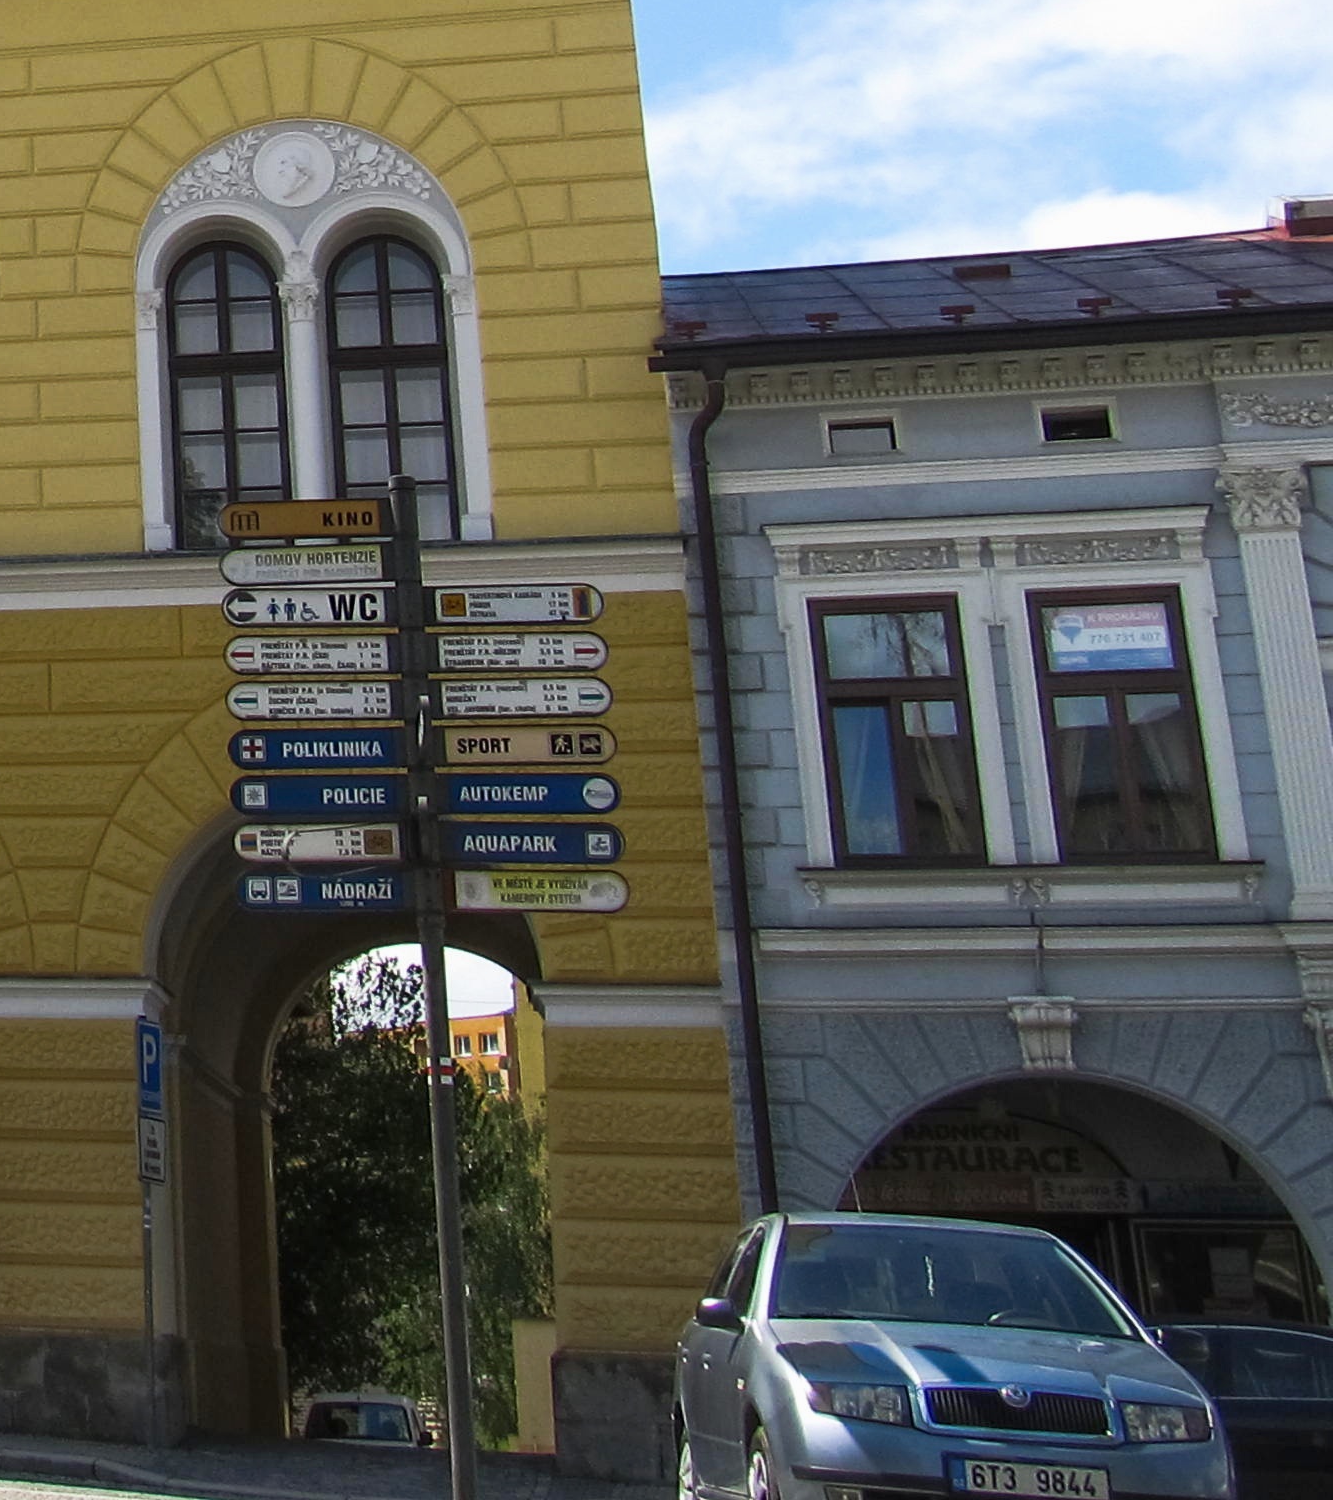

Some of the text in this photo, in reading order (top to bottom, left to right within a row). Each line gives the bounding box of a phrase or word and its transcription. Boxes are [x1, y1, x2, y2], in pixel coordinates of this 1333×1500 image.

[323, 512, 373, 526] KINO
[256, 550, 376, 566] DOMOV HORTENZIE
[328, 593, 378, 621] WC
[283, 741, 383, 758] POLIKLINIKA
[457, 738, 510, 754] SPORT
[323, 788, 386, 804] POLICIE
[460, 786, 548, 801] AUTOKEMP
[464, 835, 557, 853] AQUAPARK
[322, 878, 393, 900] NÁDRAŽÍ
[142, 1033, 156, 1083] P
[971, 1464, 1096, 1496] 6T3 9844
